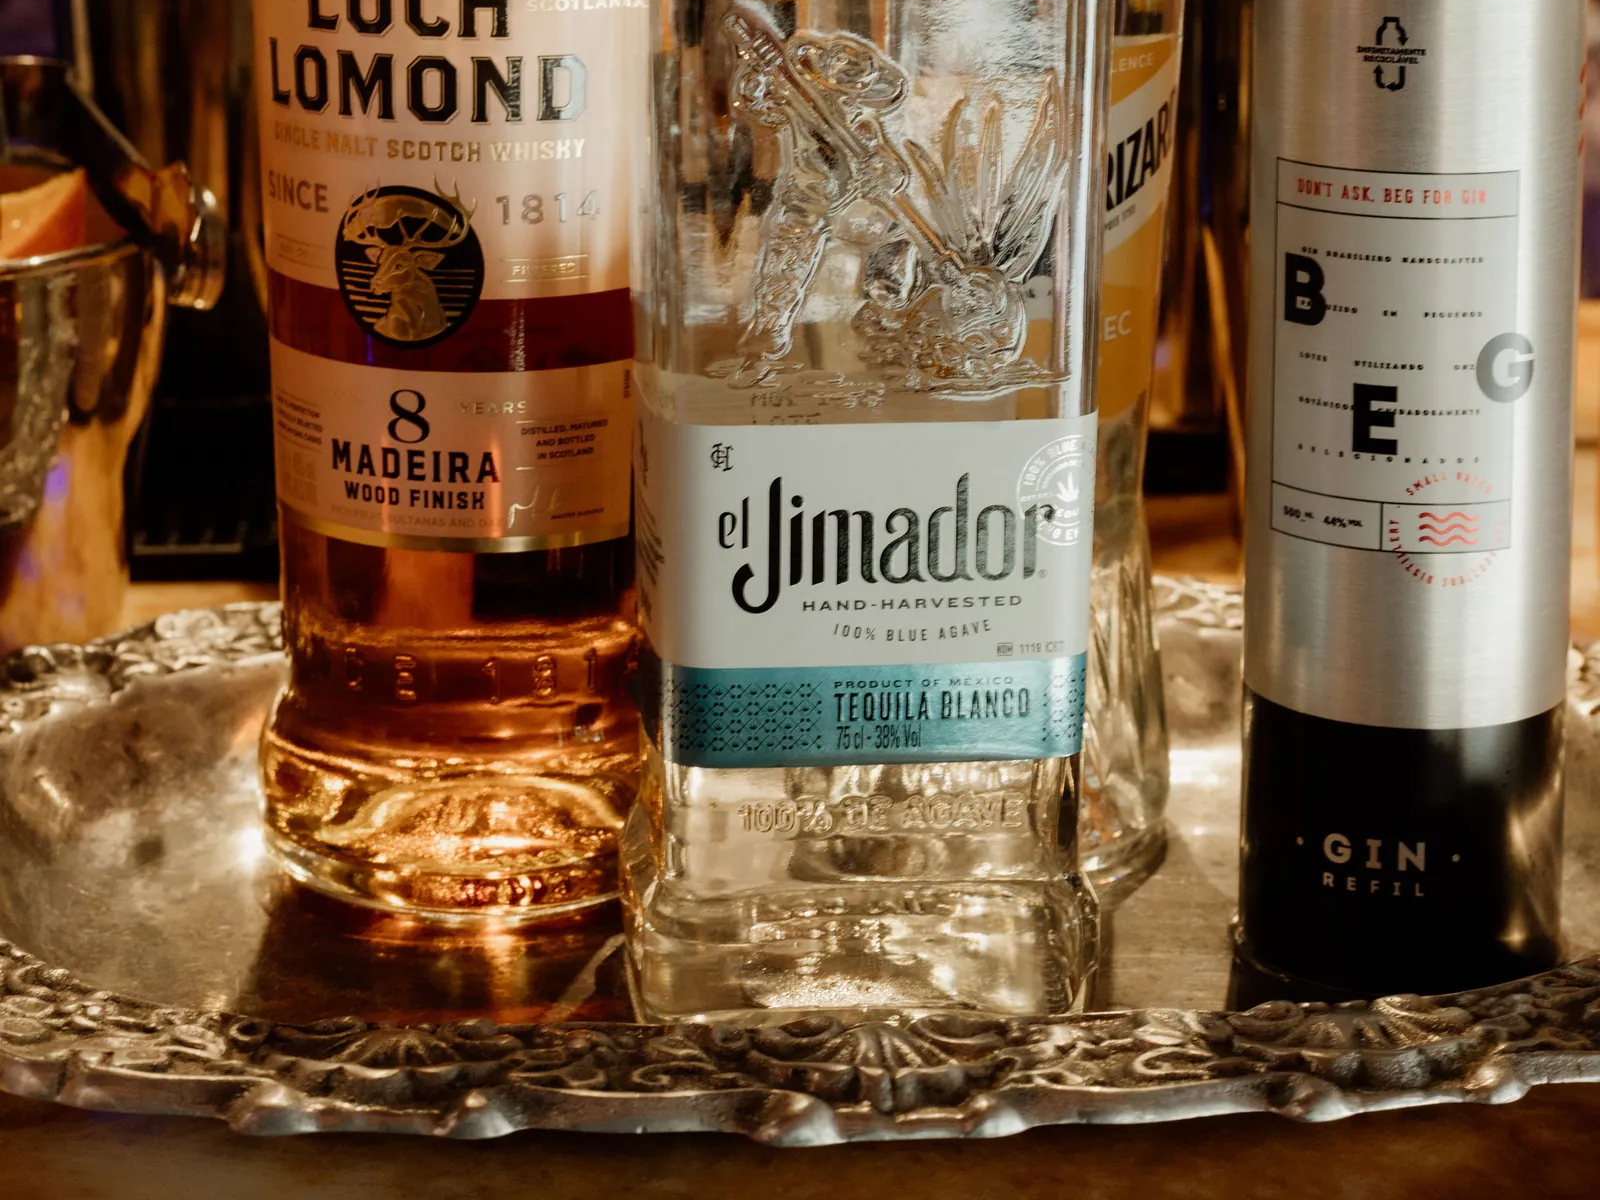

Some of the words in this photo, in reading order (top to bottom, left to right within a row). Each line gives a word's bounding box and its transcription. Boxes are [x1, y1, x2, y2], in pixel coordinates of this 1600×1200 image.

[269, 36, 588, 123] LOMOND
[273, 120, 321, 151] SINGLE
[326, 128, 378, 158] MALT
[387, 140, 482, 163] SCOTCH
[489, 137, 586, 163] WHISKY
[268, 169, 329, 213] SINCE
[496, 189, 601, 226] 1814
[1297, 178, 1333, 198] DON'T
[1341, 185, 1375, 203] ASK,
[1383, 188, 1414, 204] BEG
[1423, 189, 1453, 205] FOR
[1462, 189, 1488, 205] GIN
[1284, 251, 1326, 326] B
[1103, 310, 1132, 341] EC
[1475, 332, 1536, 404] G
[388, 388, 431, 444] 8
[460, 400, 528, 415] YEARS
[1352, 382, 1399, 456] E
[331, 439, 502, 484] MADEIRA
[344, 481, 400, 506] WOOD
[409, 489, 486, 510] FINISH
[1405, 470, 1447, 496] SMALL
[718, 495, 750, 550] el
[731, 472, 1058, 615] Jimador
[802, 595, 1023, 612] HAND-HARVESTED
[833, 623, 876, 641] 100%
[886, 628, 928, 642] BLUE
[938, 618, 992, 640] AGAVE
[834, 679, 914, 689] PRODUCT
[922, 678, 940, 688] OF
[834, 690, 931, 723] TEQUILA
[939, 687, 1031, 720] BLANCO
[875, 723, 901, 749] 38%
[904, 723, 922, 748] Vol
[901, 790, 1025, 829] AGAVE
[1323, 832, 1427, 873] GIN
[1322, 871, 1425, 898] REFIL
